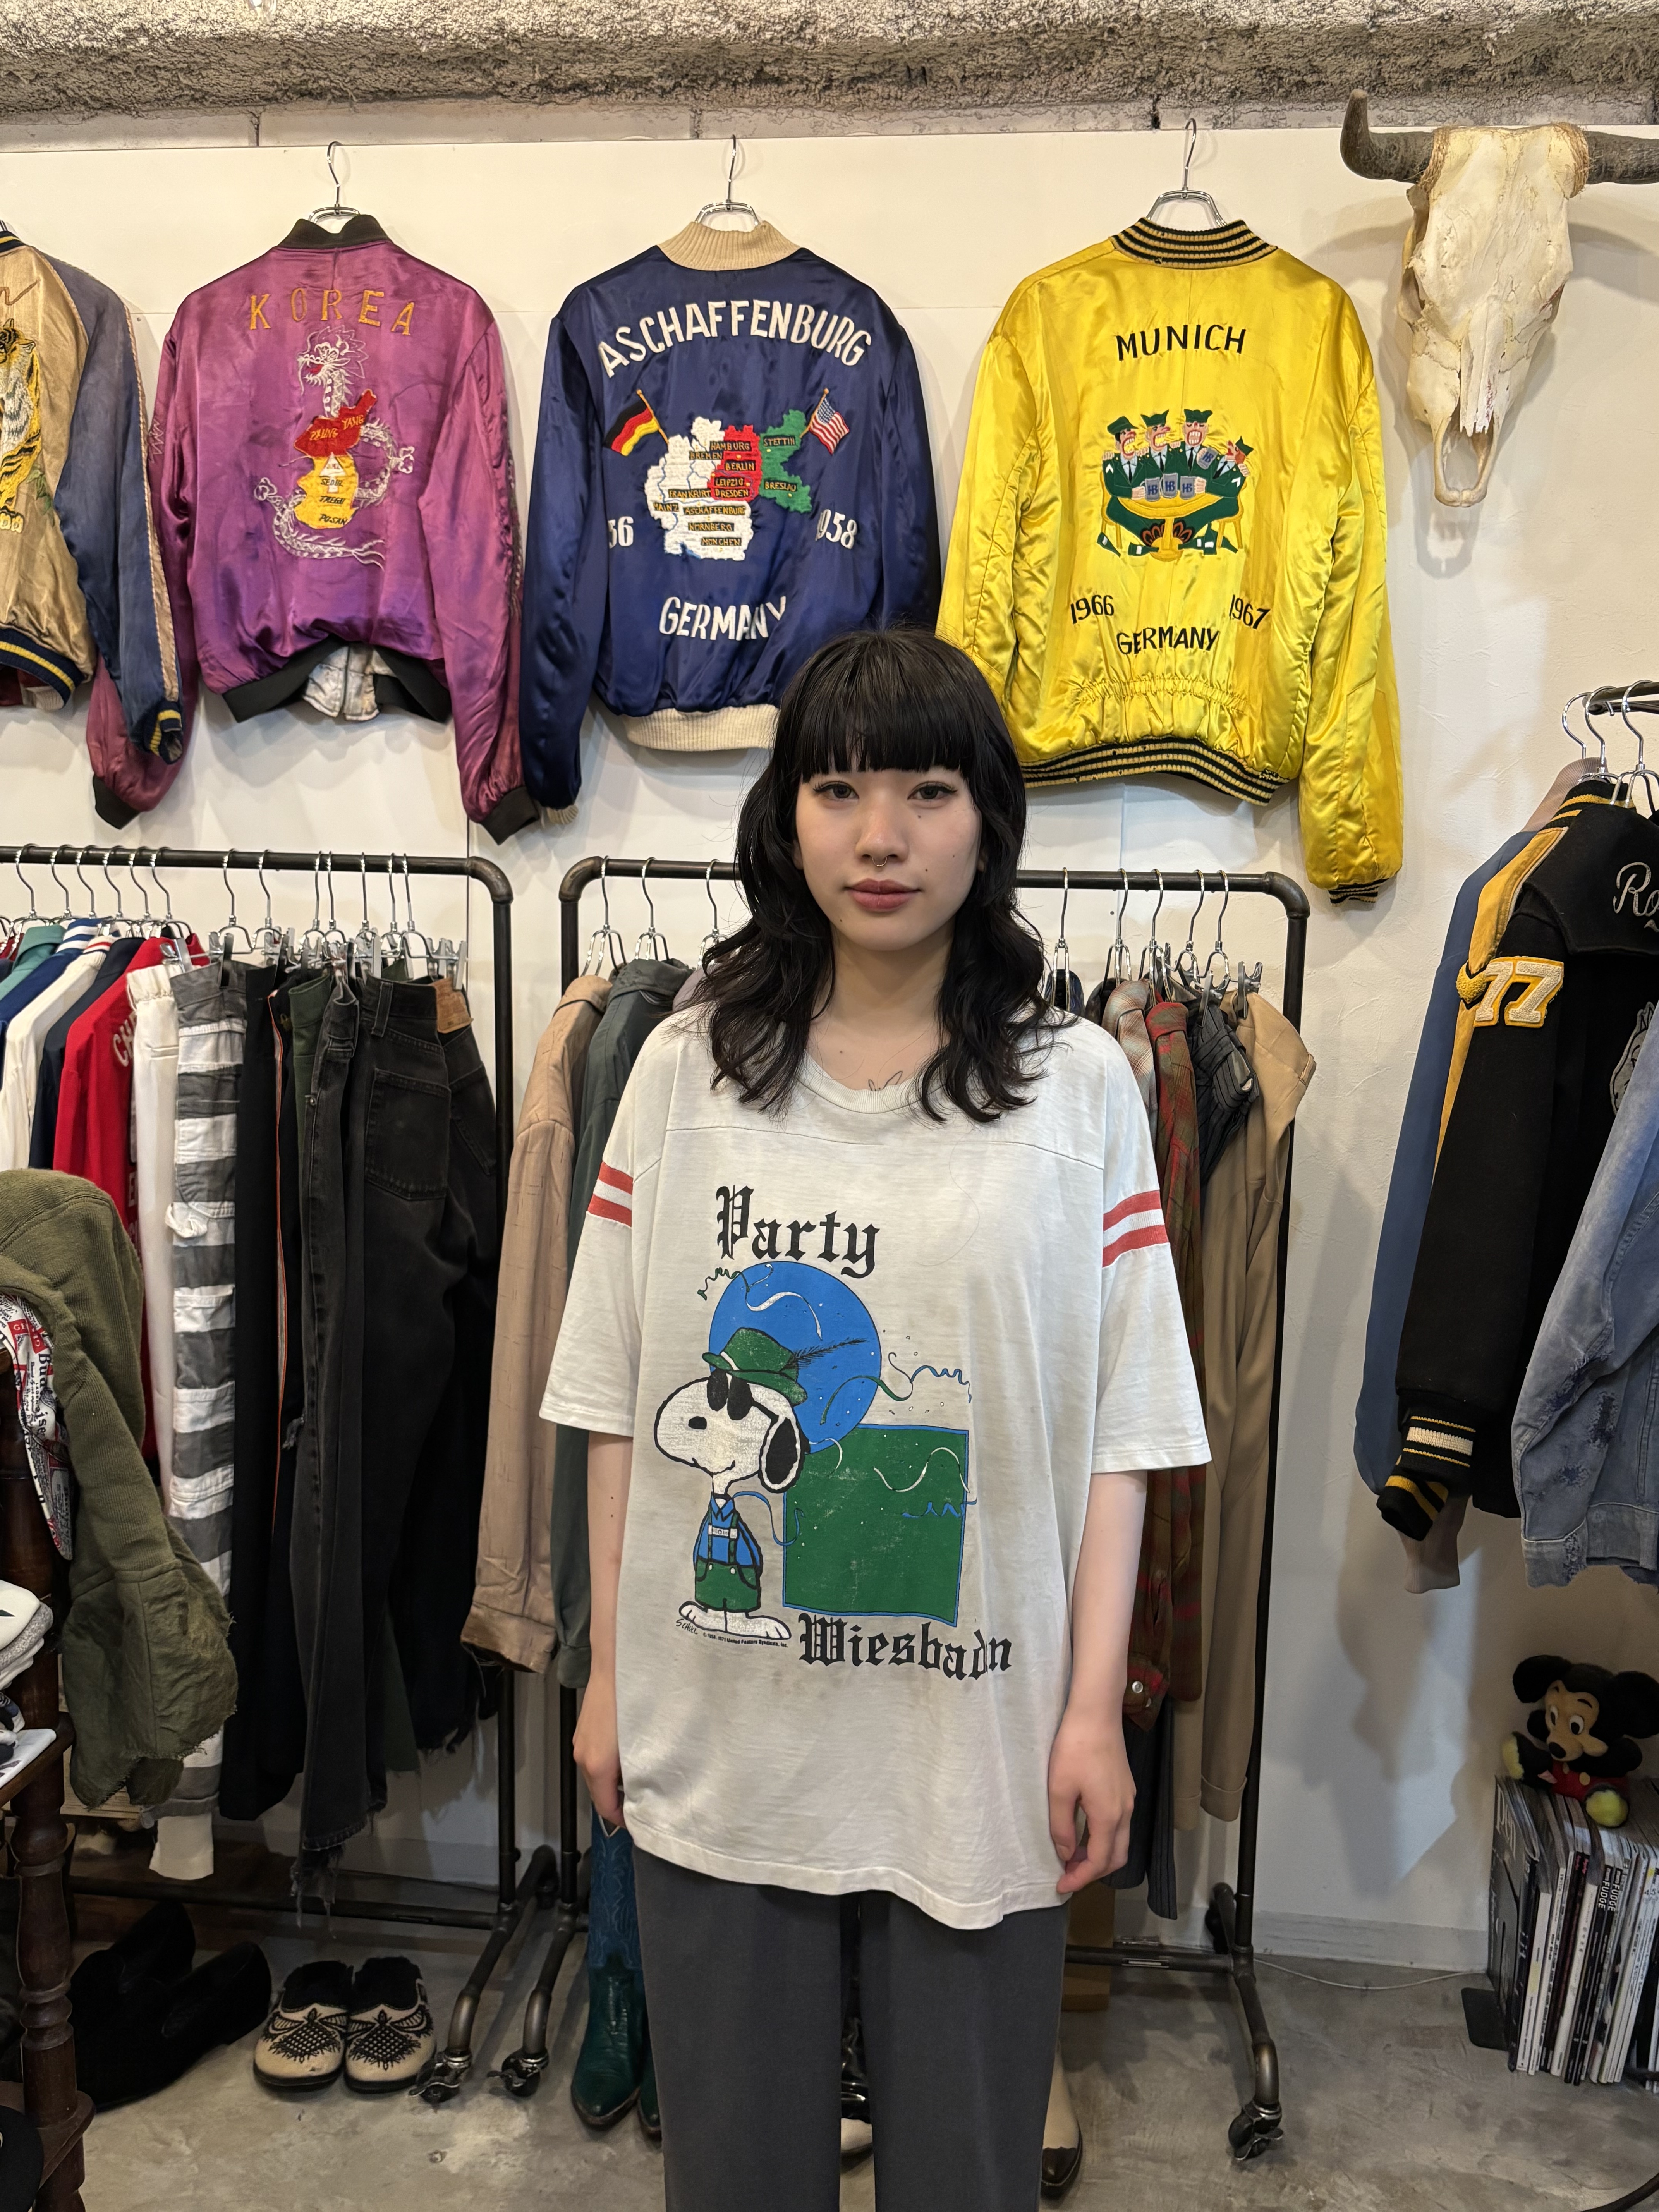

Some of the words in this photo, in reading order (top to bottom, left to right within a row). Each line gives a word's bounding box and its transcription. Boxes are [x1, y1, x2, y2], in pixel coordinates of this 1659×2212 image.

[249, 287, 415, 335] KOREA
[598, 299, 871, 378] ASCHAFFENBURG
[1116, 324, 1246, 361] MUNICH
[342, 415, 364, 430] YANG
[690, 452, 722, 460] BREMEN
[711, 441, 750, 451] HAMBURG
[763, 436, 795, 446] STETTIN
[715, 477, 744, 486] LEIPZIG
[725, 462, 755, 471] BERLIN
[764, 481, 796, 491] BRESLAU
[659, 596, 786, 641] GERMANY
[1070, 594, 1115, 625] 1966
[1229, 594, 1270, 630] 1967
[1117, 626, 1219, 655] GERMANY
[1475, 958, 1563, 1025] 77
[716, 1184, 880, 1279] Party
[1598, 1880, 1610, 1911] FUDGE
[1608, 1884, 1620, 1912] FUDGE
